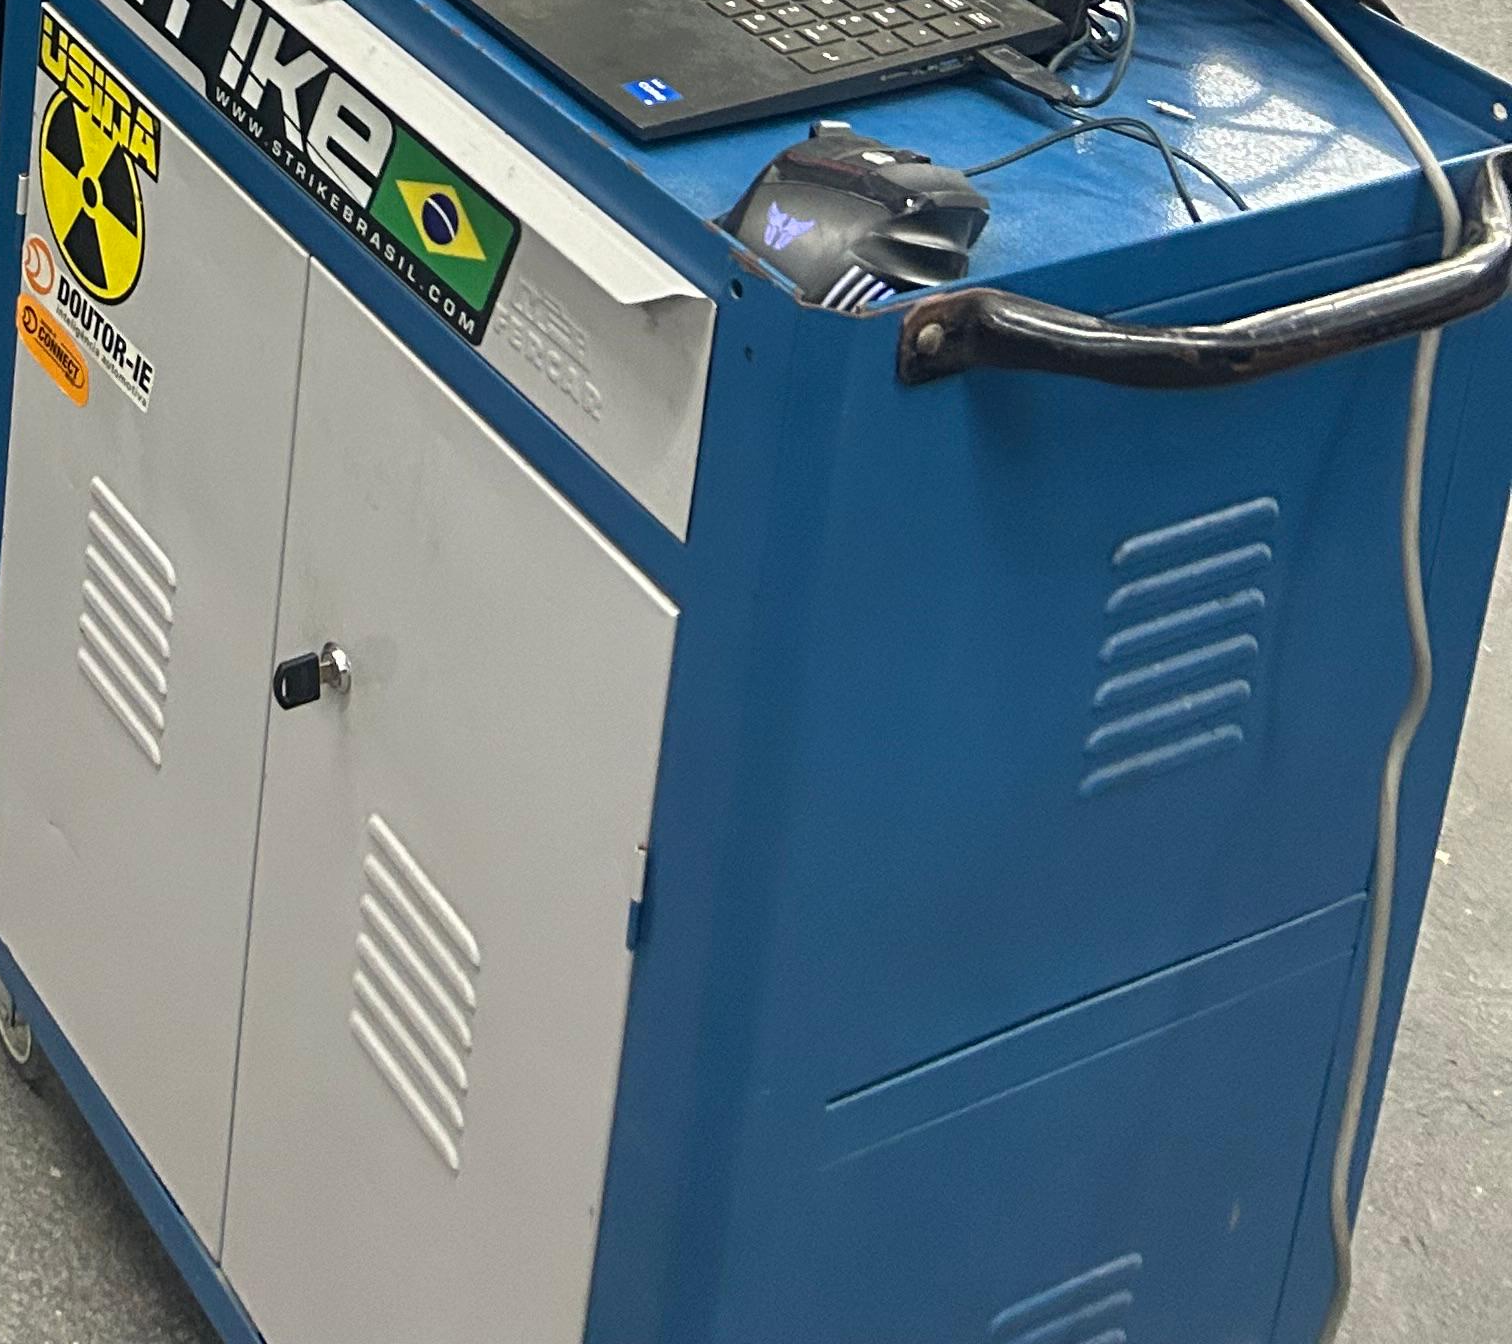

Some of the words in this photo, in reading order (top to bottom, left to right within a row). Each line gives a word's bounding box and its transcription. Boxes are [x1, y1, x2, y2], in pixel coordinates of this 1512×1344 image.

[41, 14, 158, 177] USINA
[214, 86, 476, 337] WWW.STRIKEBRASIL.COM
[37, 325, 80, 380] CONNECT
[57, 275, 153, 395] DOUTOR-IE
